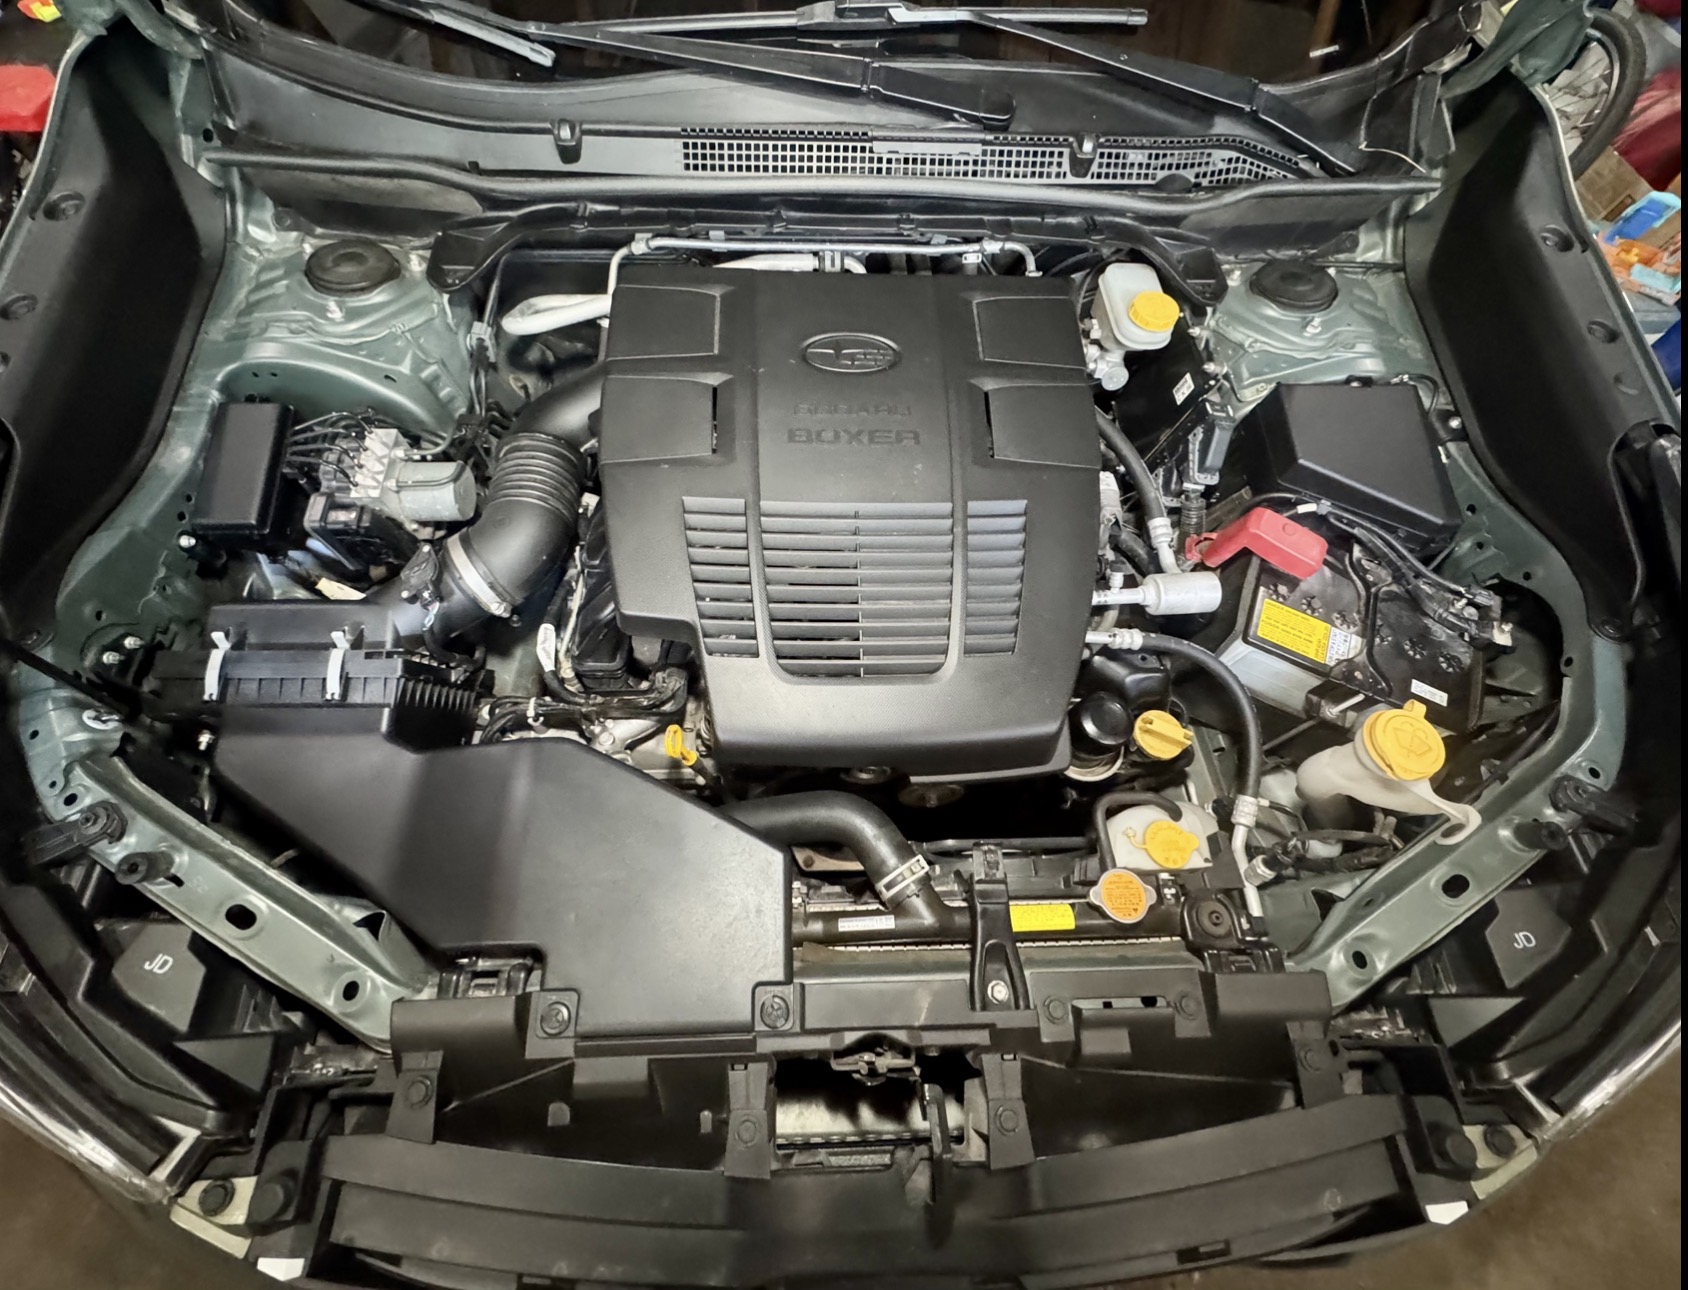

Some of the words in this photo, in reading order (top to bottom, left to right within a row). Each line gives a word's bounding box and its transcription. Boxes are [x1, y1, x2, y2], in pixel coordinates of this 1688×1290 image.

[788, 428, 921, 445] BOXER
[1513, 931, 1536, 949] JD
[143, 953, 174, 974] JD
